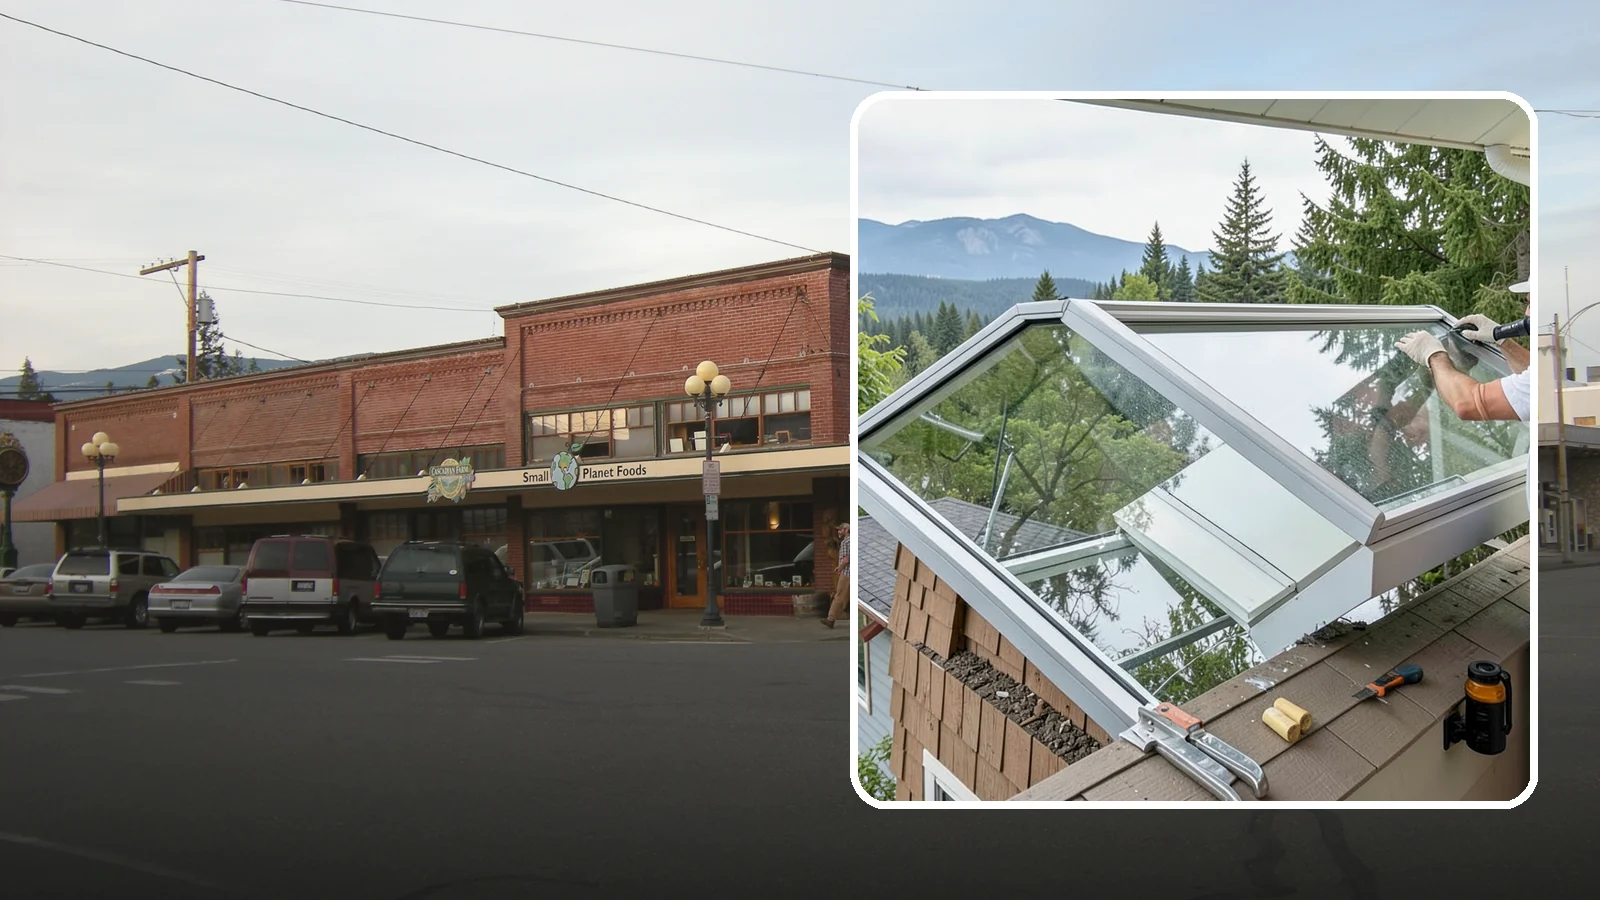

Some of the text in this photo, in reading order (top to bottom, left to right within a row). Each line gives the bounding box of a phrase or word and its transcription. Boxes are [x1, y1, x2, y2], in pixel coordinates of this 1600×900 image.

[431, 465, 469, 476] CASCADIAN FARM
[523, 464, 647, 483] Small Planet Foods
